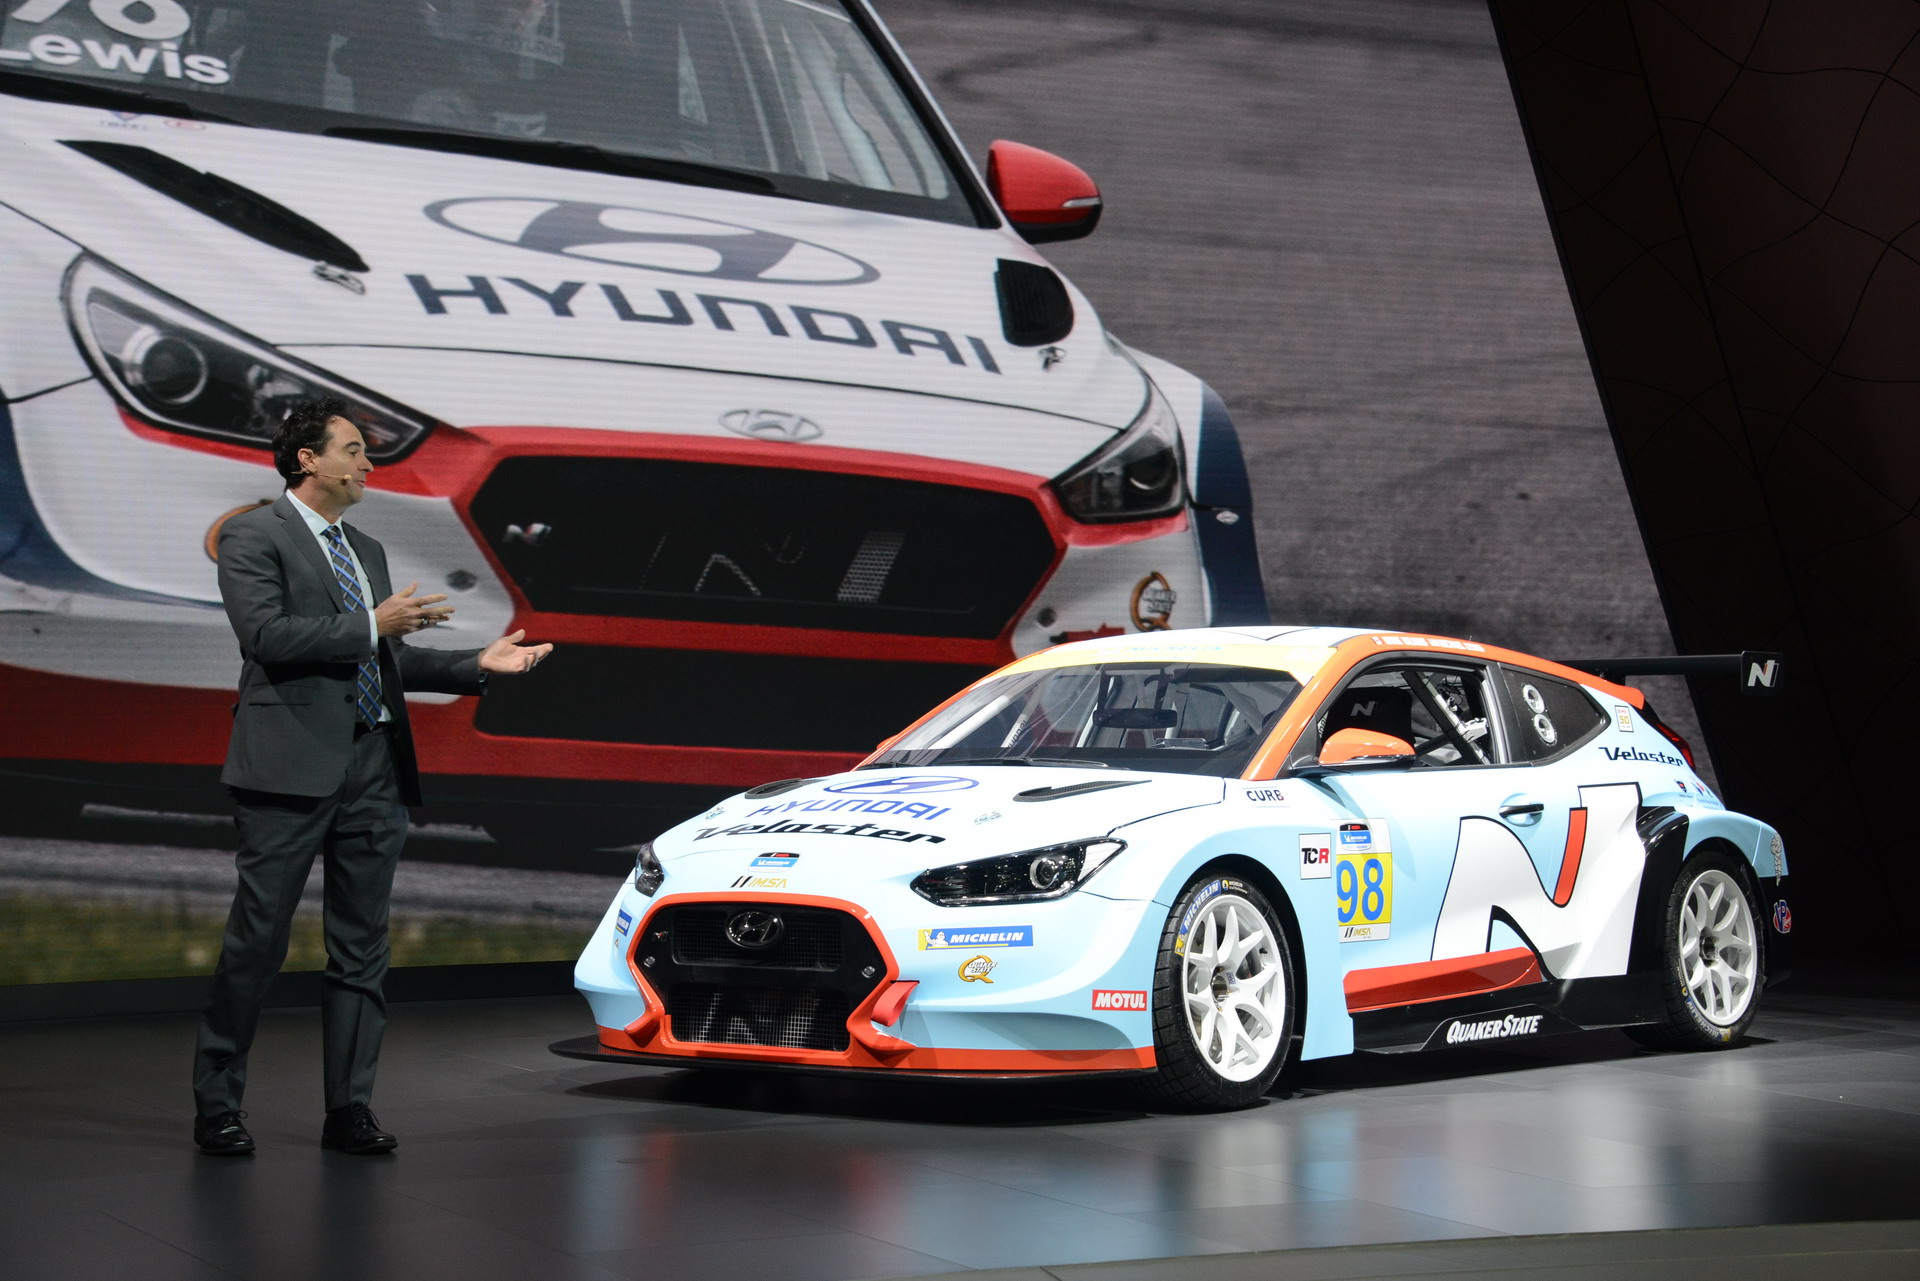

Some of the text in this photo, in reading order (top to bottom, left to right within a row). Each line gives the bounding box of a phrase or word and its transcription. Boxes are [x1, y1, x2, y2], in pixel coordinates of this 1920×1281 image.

[405, 273, 1002, 375] HYUNDAI
[1598, 746, 1684, 767] Veloster
[1246, 789, 1285, 802] CURB
[744, 799, 952, 821] HYUNDAI
[692, 819, 947, 844] Veloster
[1301, 847, 1330, 865] TCR
[1336, 858, 1385, 924] 98
[1183, 882, 1220, 931] MICHELIN
[950, 932, 1024, 944] MICHELIN
[1095, 992, 1146, 1009] MOTUL
